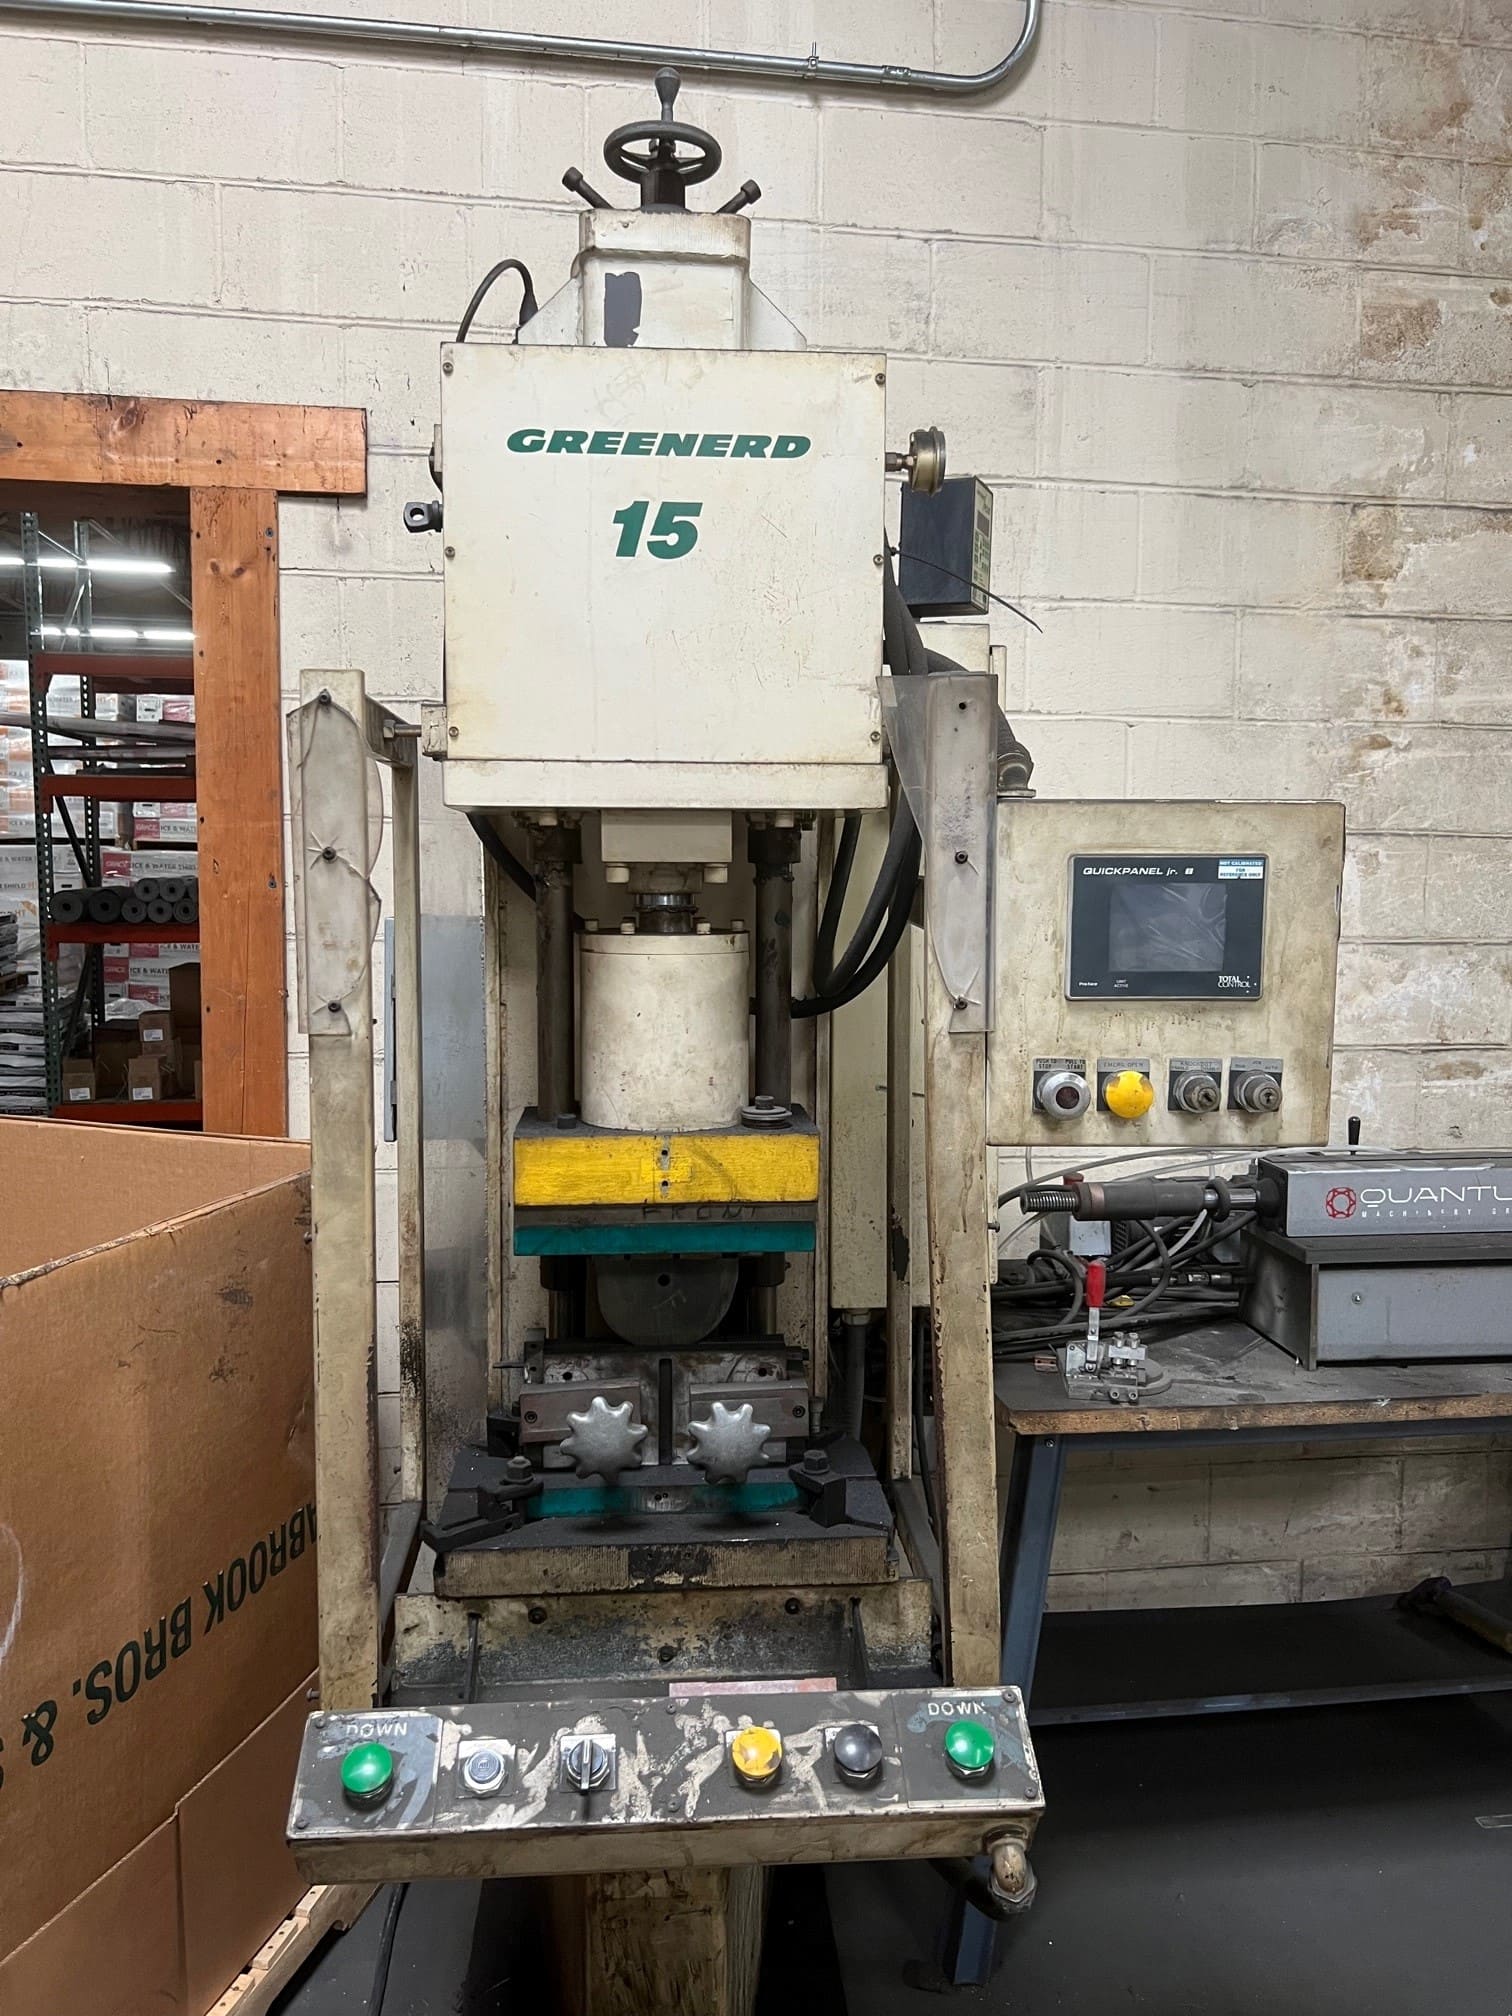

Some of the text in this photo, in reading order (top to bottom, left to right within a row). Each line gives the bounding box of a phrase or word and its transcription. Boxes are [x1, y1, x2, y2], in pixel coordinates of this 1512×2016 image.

[506, 428, 812, 459] GREENERD
[612, 500, 703, 560] 15
[1082, 866, 1164, 876] QUICKPANEL
[1165, 866, 1179, 877] jr.
[1218, 975, 1241, 983] TOTAL
[71, 1596, 192, 1726] BROS.
[927, 1701, 987, 1716] DOWN
[20, 1699, 57, 1767] &
[345, 1721, 408, 1738] DOWN
